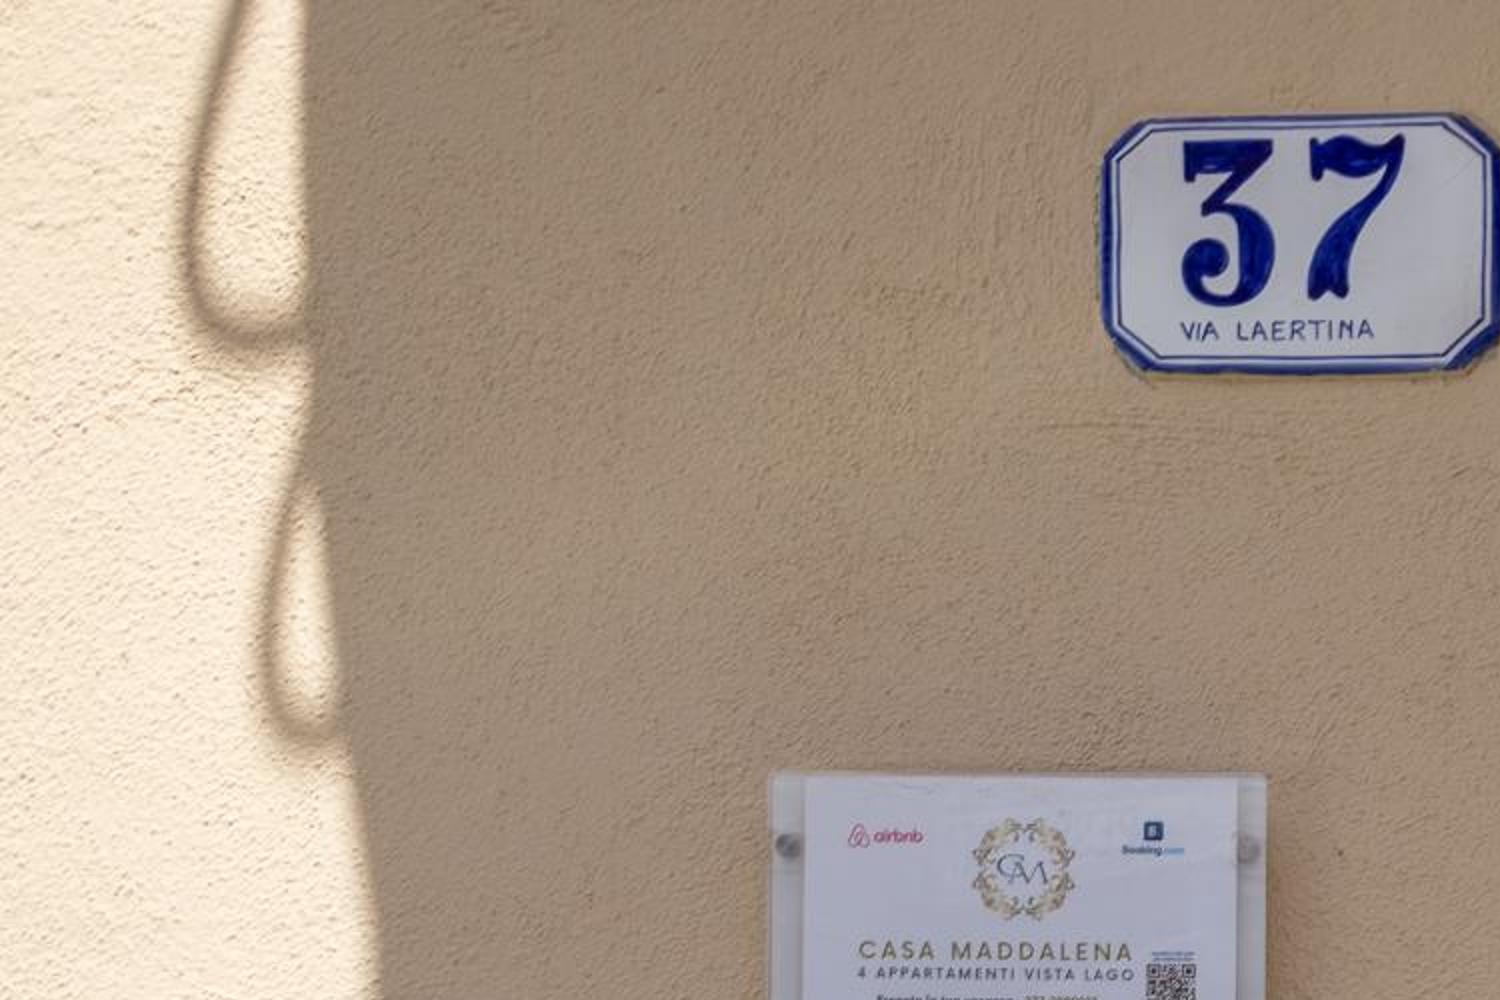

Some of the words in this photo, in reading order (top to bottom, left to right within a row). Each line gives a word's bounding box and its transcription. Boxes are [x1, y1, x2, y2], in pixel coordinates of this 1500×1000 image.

[1182, 134, 1406, 307] 37
[1180, 321, 1219, 341] VIA
[1237, 319, 1375, 341] LAERTINA
[873, 826, 924, 843] airbnb
[1122, 844, 1184, 856] Booking
[858, 940, 934, 960] CASA
[951, 940, 1132, 961] MADDALENA
[857, 967, 866, 978] 4
[876, 966, 1015, 979] APPARTAMENTI
[1024, 967, 1075, 981] VISTA
[1084, 968, 1135, 981] LAGO
